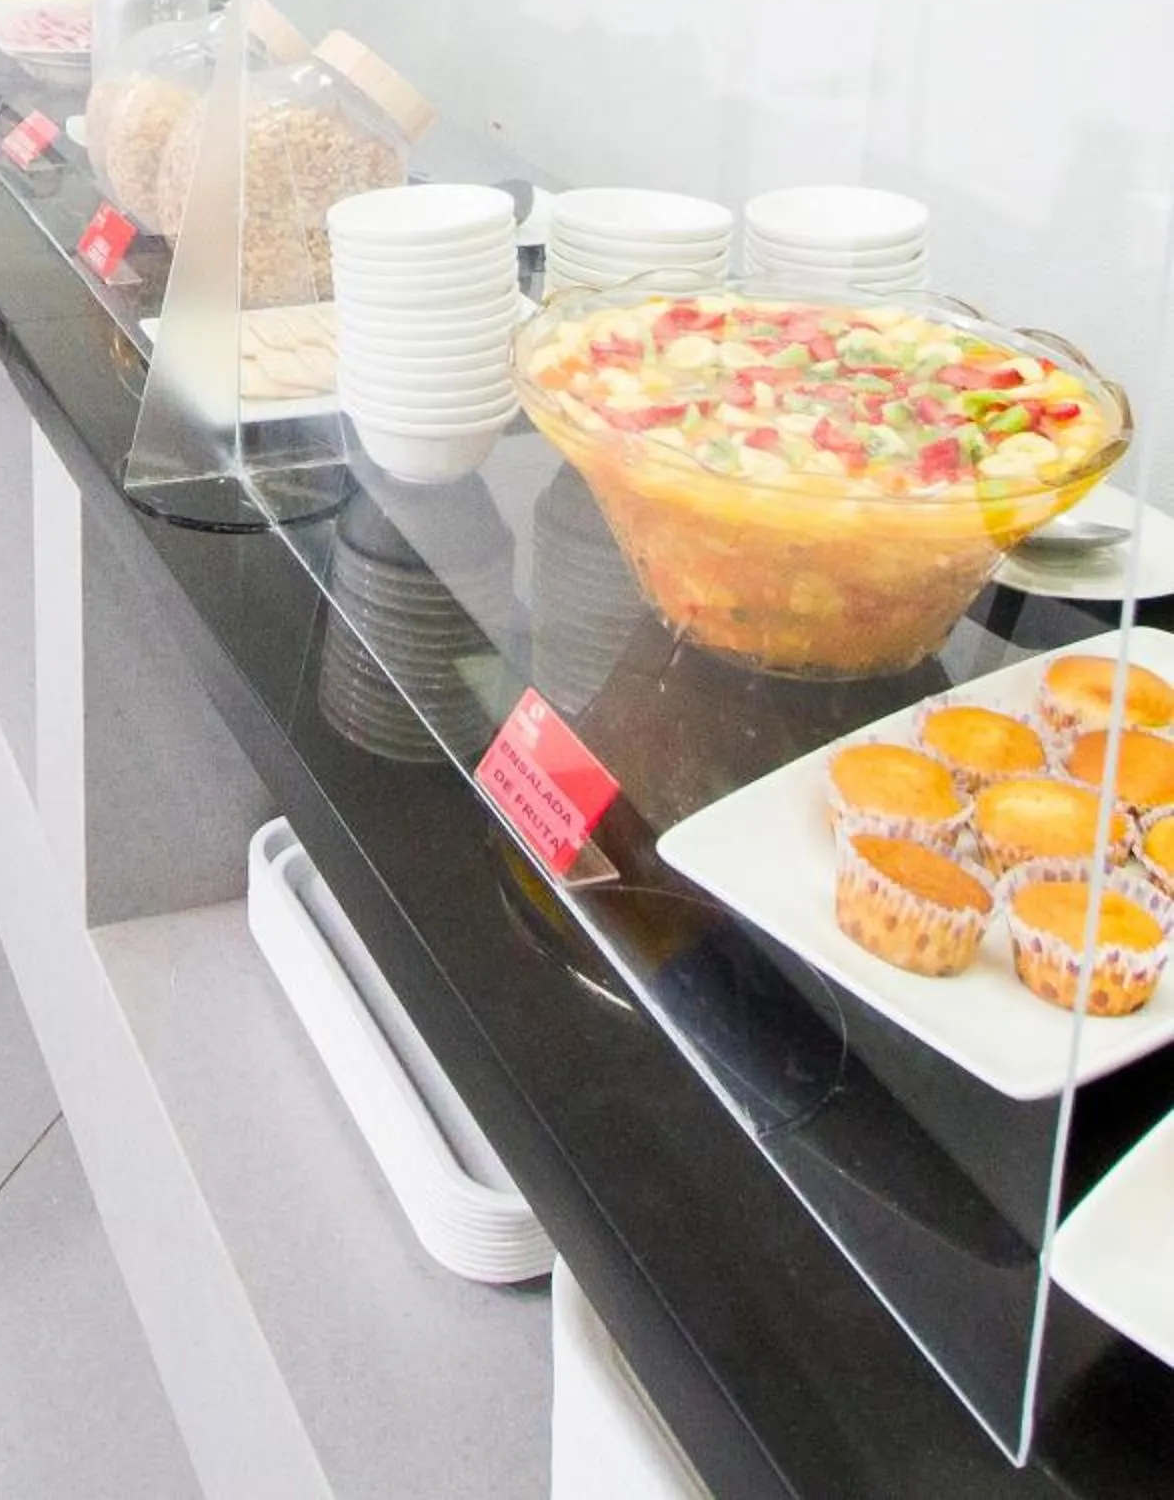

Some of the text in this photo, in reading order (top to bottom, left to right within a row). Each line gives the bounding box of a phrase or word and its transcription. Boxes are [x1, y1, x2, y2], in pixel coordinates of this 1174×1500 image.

[493, 768, 560, 851] DE FRUTA
[499, 742, 571, 826] ENSALADA
